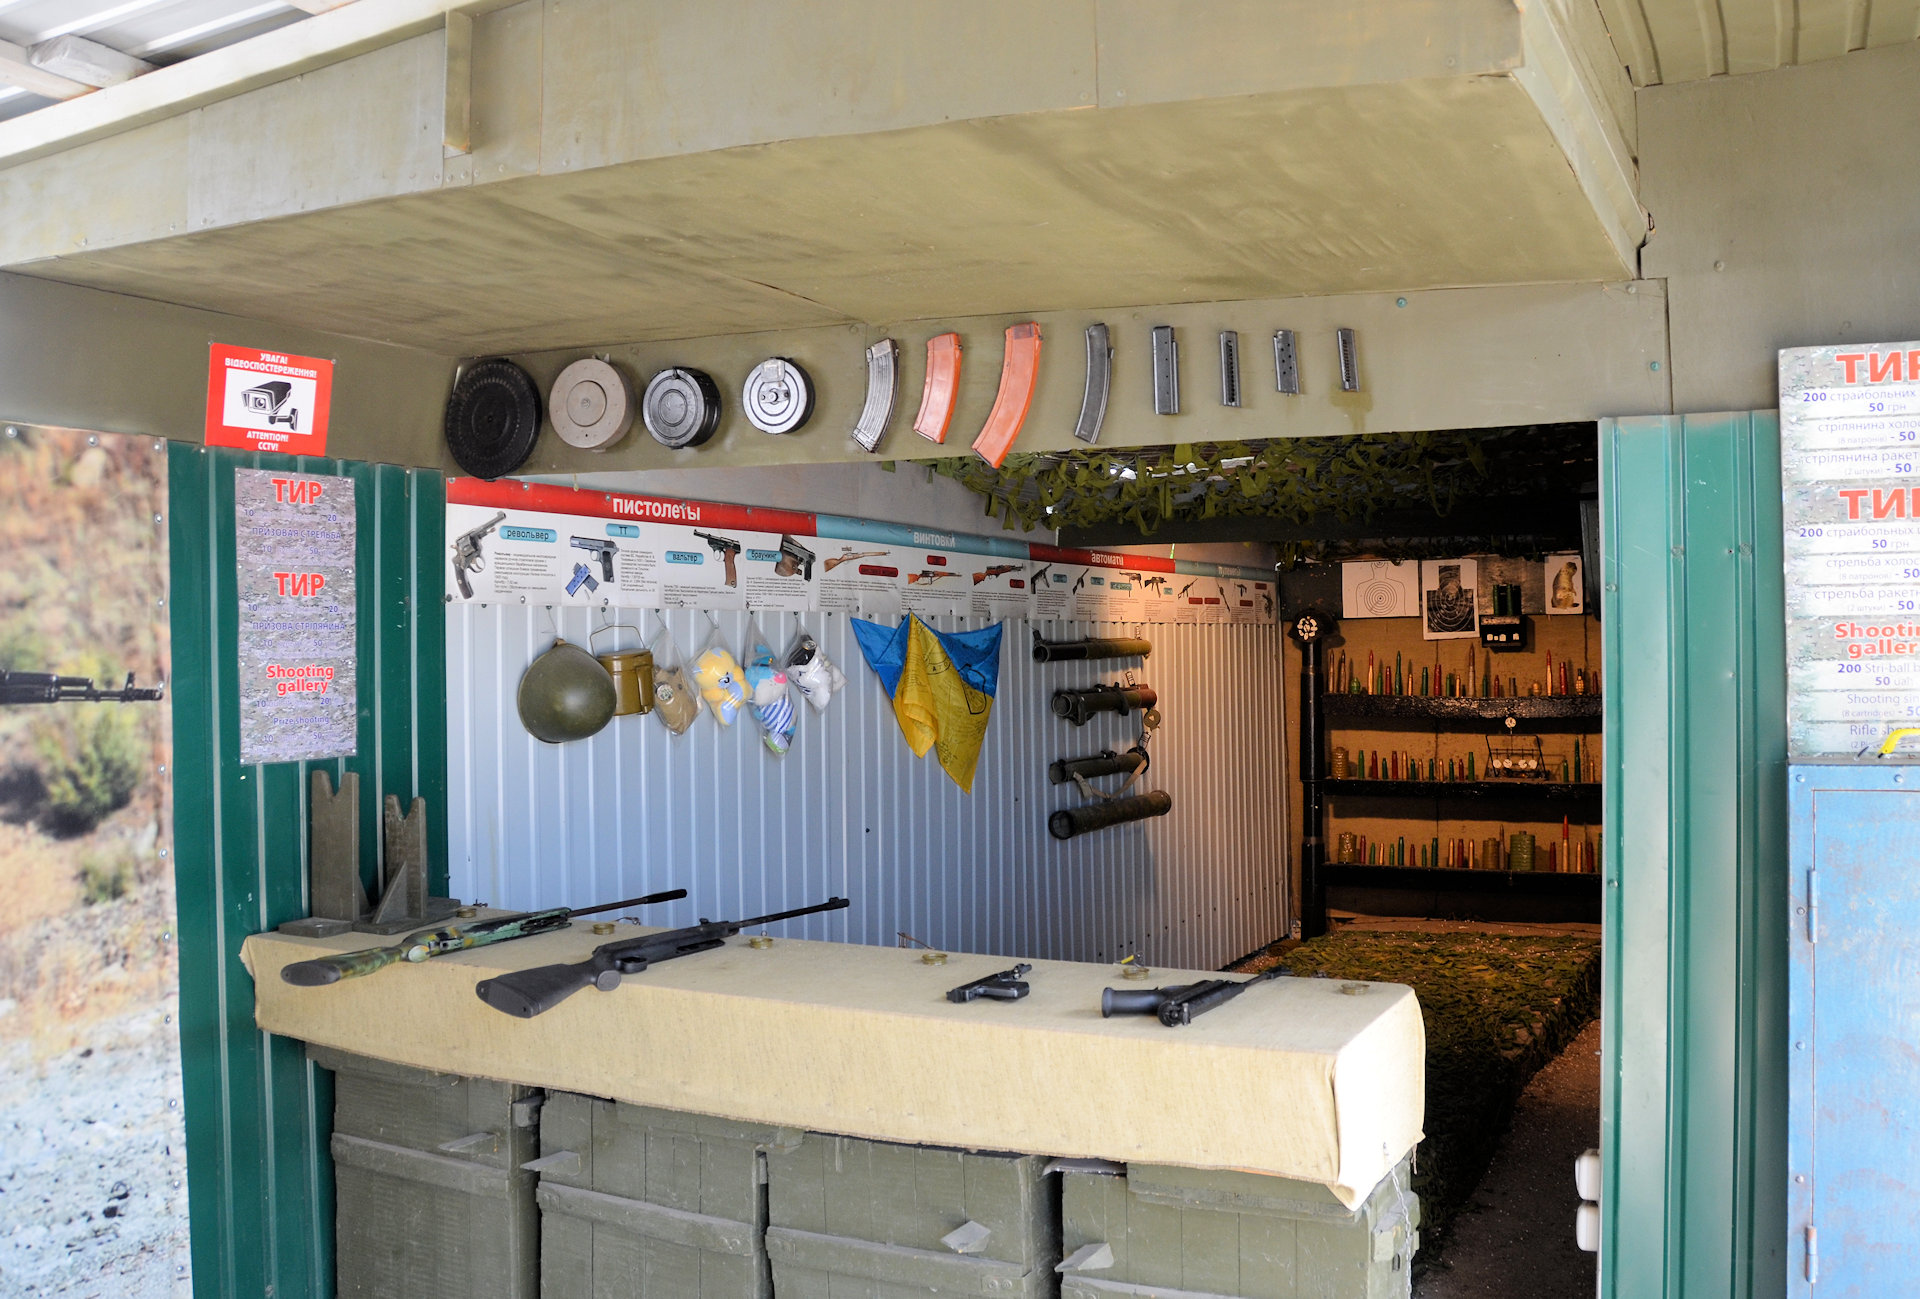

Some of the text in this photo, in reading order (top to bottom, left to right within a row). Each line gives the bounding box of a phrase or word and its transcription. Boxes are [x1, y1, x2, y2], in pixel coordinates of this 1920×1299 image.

[260, 353, 288, 365] УВАГА!
[225, 358, 317, 379] ВІДЕОСПОСТЕРЕЖЕННЯ!
[1803, 390, 1916, 402] 200 страйбольних
[1869, 402, 1906, 413] 50 грн
[1818, 422, 1885, 433] стрілянина
[246, 430, 289, 442] ATTENTION!
[1899, 431, 1916, 441] 50
[258, 441, 279, 451] CCTV!
[1805, 453, 1878, 466] стрілянина
[1895, 463, 1912, 473] 50
[271, 478, 323, 504] ТИР
[252, 528, 341, 539] ПРИЗОВАЯ СТРЕЛЬБА
[507, 529, 549, 541] револьвер
[1799, 528, 1823, 537] 200
[1826, 526, 1914, 539] страйбольных
[1872, 539, 1909, 550] 50 грн
[672, 554, 698, 563] вальтер
[751, 550, 777, 560] браунинг
[1826, 556, 1881, 568] стрельба
[1903, 568, 1920, 579] 50
[273, 572, 325, 596] ТИР
[1814, 588, 1874, 600] стрельба
[1897, 600, 1914, 610] 50
[295, 622, 345, 630] СТРІЛЯНИНА
[266, 664, 334, 680] Shooting
[1837, 663, 1862, 673] 200
[1875, 676, 1891, 686] 50
[277, 679, 328, 697] gallery
[1847, 694, 1900, 706] Shooting
[273, 716, 330, 726] Prize shooting
[1850, 724, 1877, 735] Rifle
